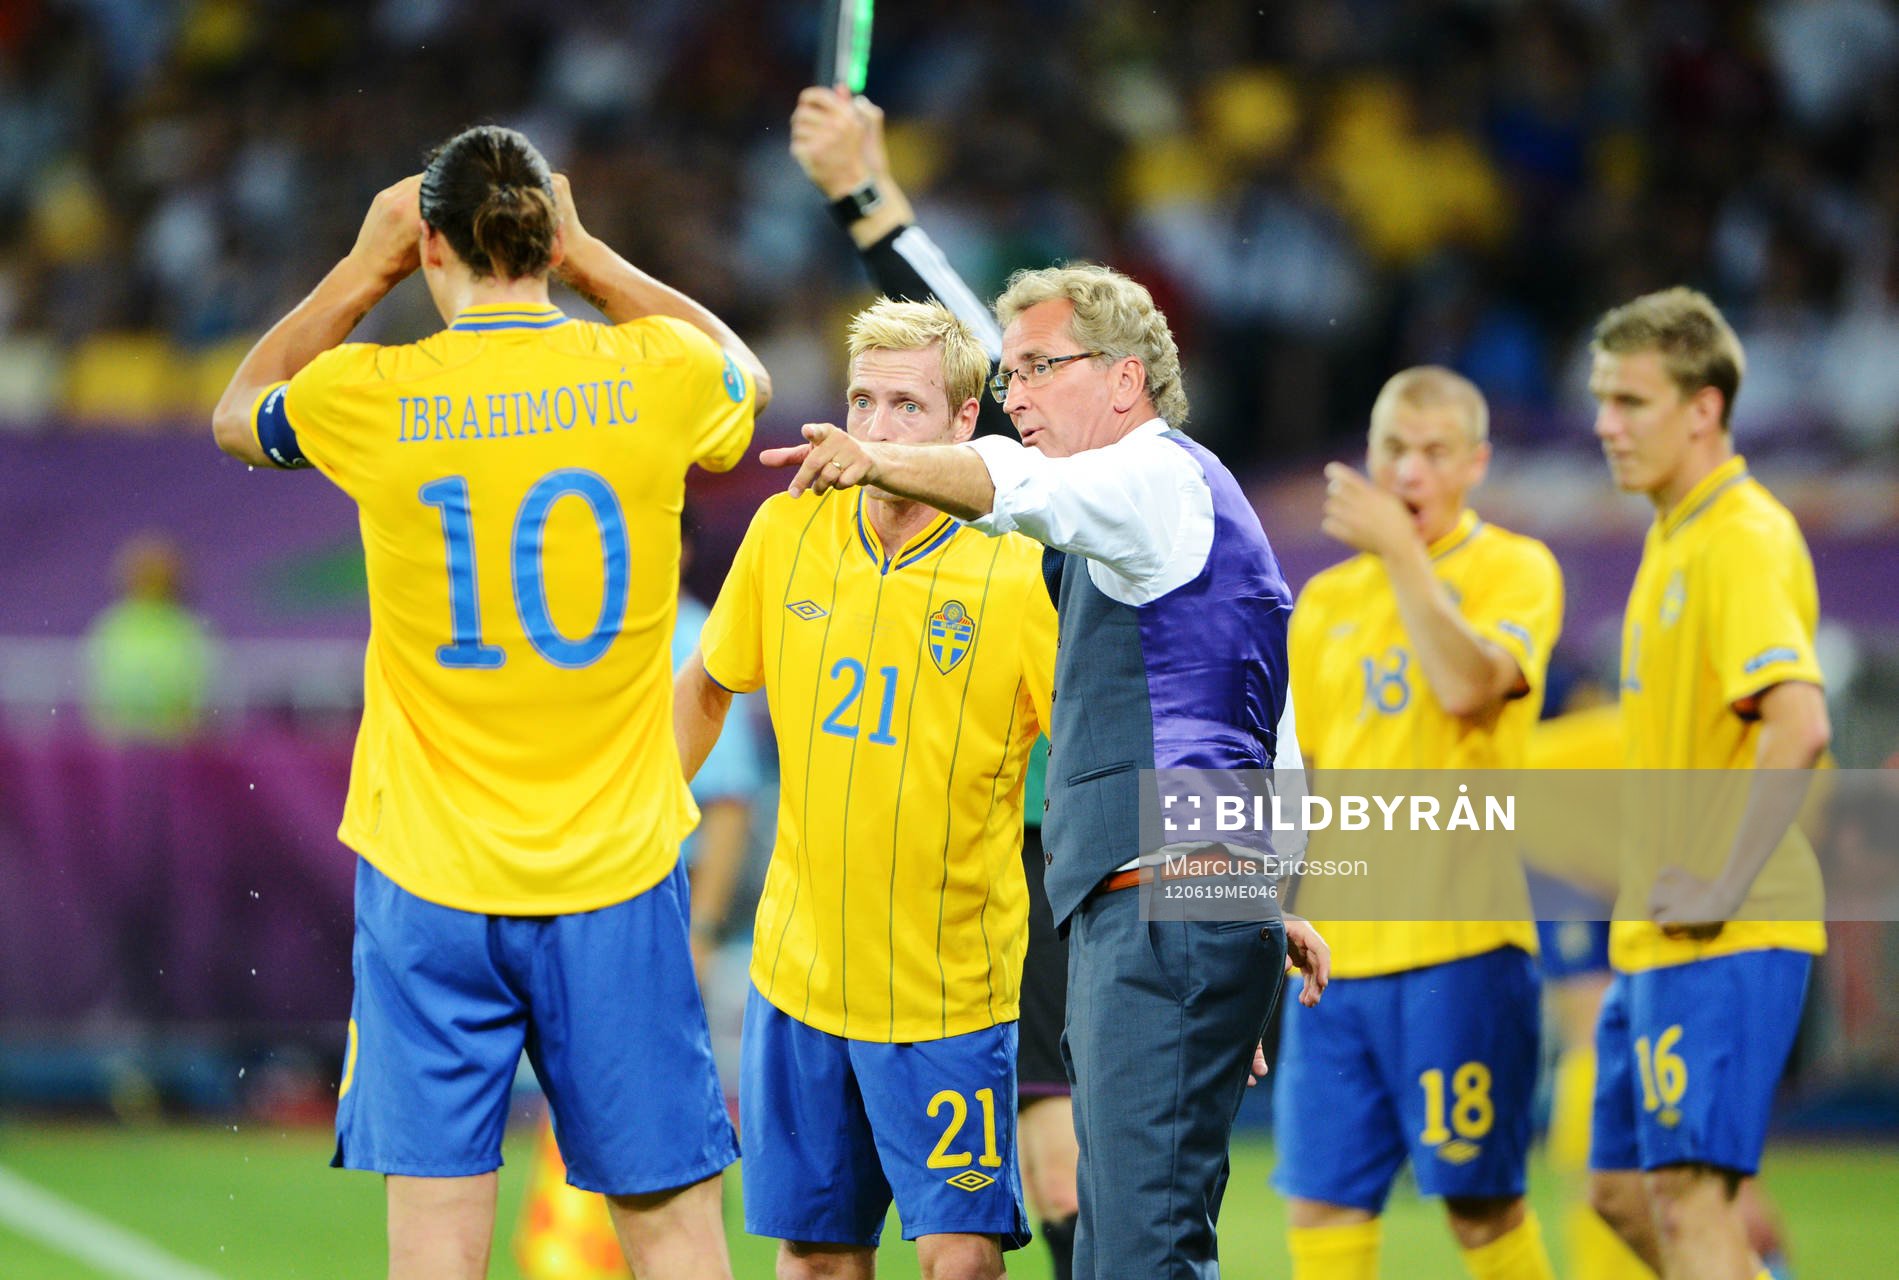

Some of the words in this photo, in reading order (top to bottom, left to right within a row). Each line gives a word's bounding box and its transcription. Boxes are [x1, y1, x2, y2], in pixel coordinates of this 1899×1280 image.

[398, 366, 637, 441] IBRAHIMOVIĆ
[419, 468, 630, 669] 10
[821, 656, 899, 746] 21
[1419, 1061, 1494, 1145] 18
[1635, 1024, 1687, 1111] 16
[926, 1087, 1002, 1169] 21
